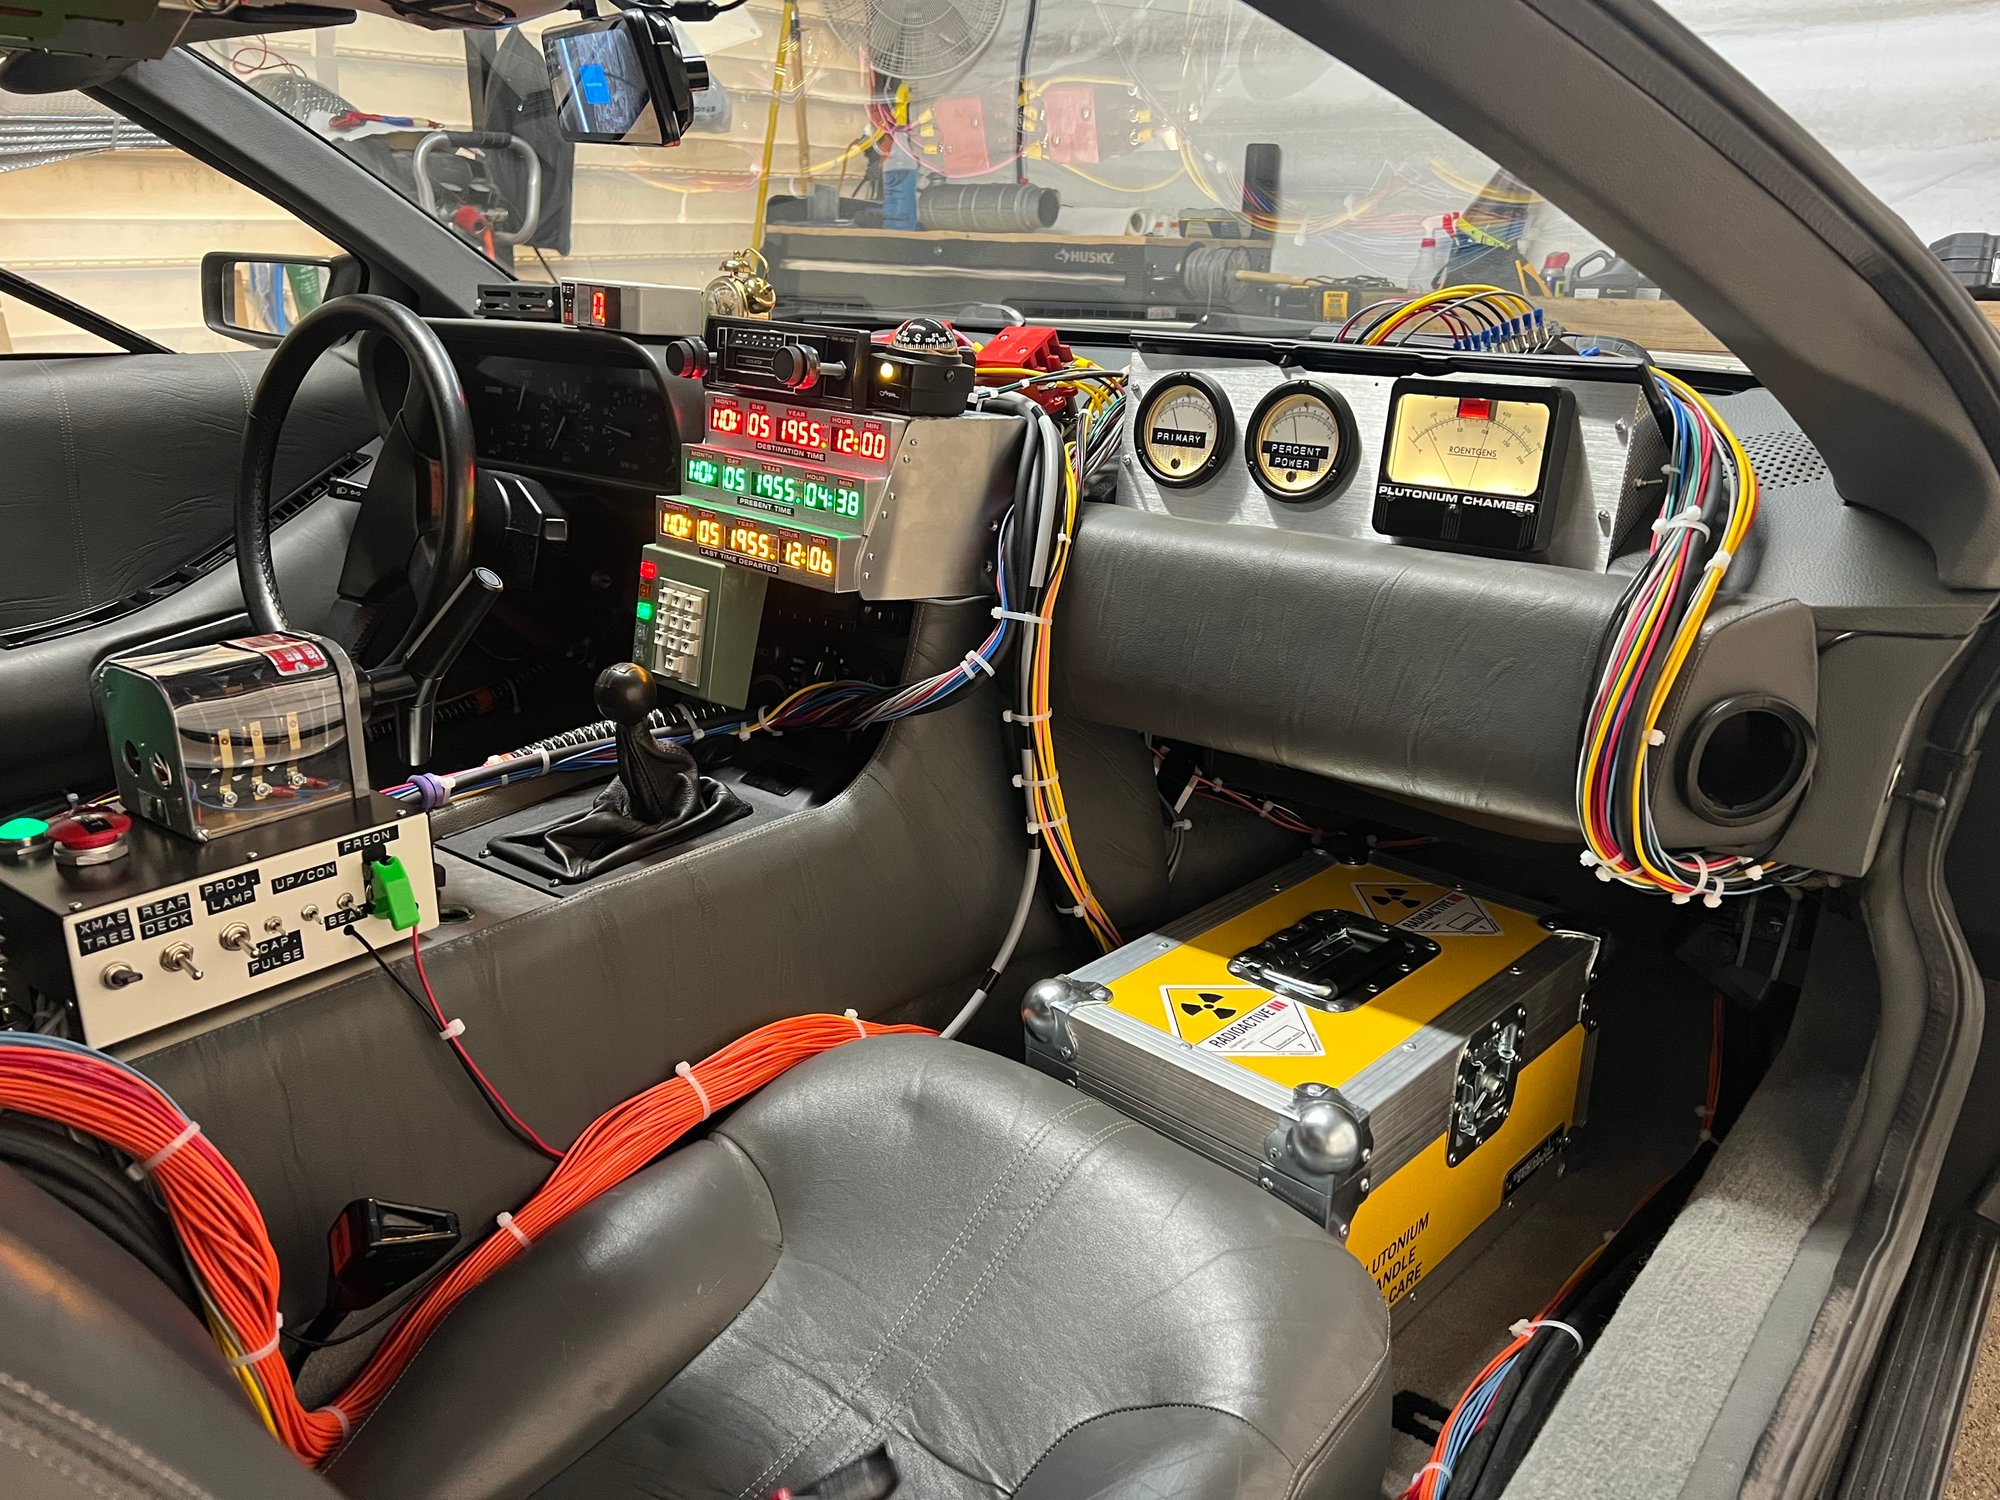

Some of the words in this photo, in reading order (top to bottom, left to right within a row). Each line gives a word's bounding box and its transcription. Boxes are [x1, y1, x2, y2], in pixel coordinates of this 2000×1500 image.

[1070, 251, 1114, 264] HUSKY
[913, 333, 922, 343] S
[715, 398, 737, 406] MONTH
[788, 410, 806, 418] YEAR
[832, 417, 851, 425] HOUR
[749, 413, 770, 437] 05
[781, 419, 821, 447] 1955
[1157, 432, 1201, 443] PRIMARY
[757, 442, 804, 457] DESTINATION
[806, 451, 824, 460] TIME
[1271, 444, 1321, 456] PERCENT
[1449, 446, 1497, 457] ROENTGENS
[691, 451, 713, 459] MONTH
[763, 465, 780, 473] YEAR
[806, 473, 825, 481] HOUR
[1274, 457, 1310, 469] POWER
[725, 466, 745, 491] 05
[756, 474, 795, 502] 1955
[739, 498, 772, 511] PRESENT
[774, 505, 792, 515] TIME
[1379, 486, 1458, 504] PLUTONIUM
[1462, 496, 1535, 514] CHAMBER
[666, 503, 687, 512] MONTH
[737, 520, 755, 528] YEAR
[780, 530, 798, 539] HOUR
[813, 537, 826, 545] MIN
[699, 520, 720, 544] 05
[731, 529, 769, 557] 1955
[700, 549, 718, 559] LAST
[720, 553, 737, 562] TIME
[738, 558, 778, 573] DEPARTED
[343, 830, 391, 852] FREON
[204, 874, 255, 896] PROJ.
[275, 864, 336, 890] UP/CON
[142, 896, 188, 918] REAR
[211, 891, 253, 911] LAMP
[80, 912, 127, 935] XMAS
[145, 913, 190, 935] DECK
[1402, 900, 1456, 929] RADIOACTIVE
[83, 928, 131, 950] TREE
[260, 937, 298, 954] CAP.
[251, 949, 302, 973] PULSE
[1209, 1007, 1275, 1048] RADIOACTIVE
[1366, 1211, 1430, 1274] UTONIUM
[1376, 1245, 1416, 1291] ANDLE
[1389, 1261, 1422, 1304] CARE
